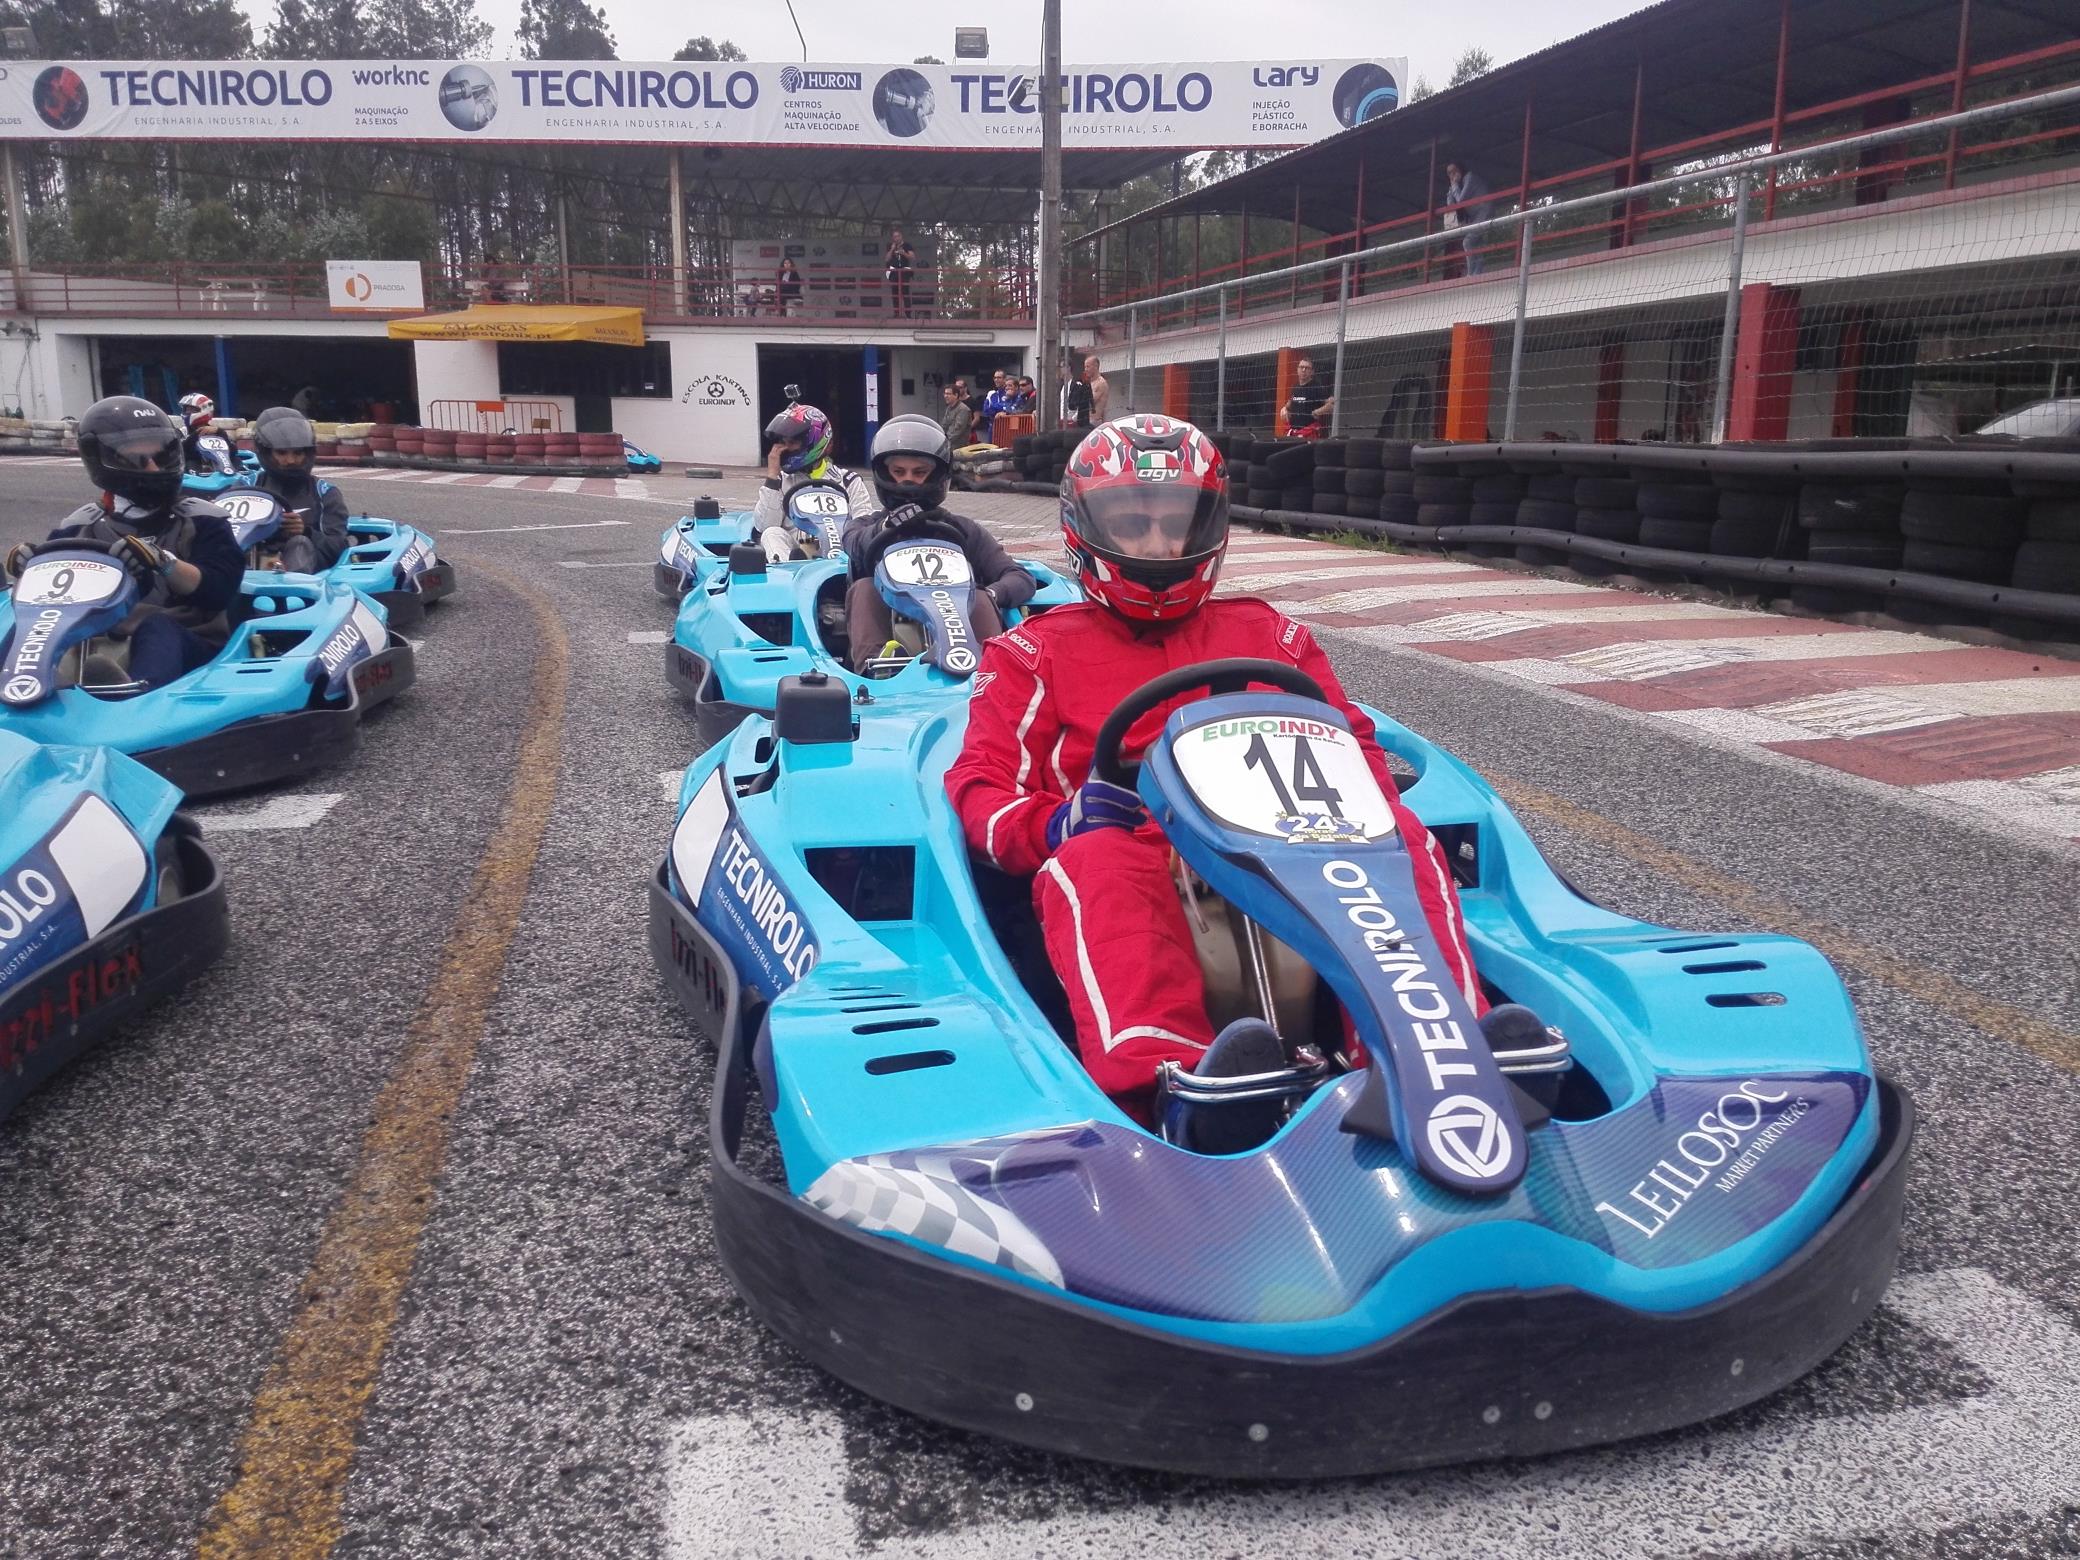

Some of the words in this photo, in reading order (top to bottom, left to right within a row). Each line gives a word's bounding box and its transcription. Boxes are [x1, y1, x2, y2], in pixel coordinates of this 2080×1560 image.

[352, 64, 430, 85] worknc
[808, 73, 857, 88] HURON
[100, 69, 333, 106] TECNIROLO
[511, 69, 759, 109] TECNIROLO
[354, 105, 409, 116] MAQUINAÇÃO
[784, 100, 822, 108] CENTROS
[1252, 99, 1290, 110] INJEÇÃO
[134, 116, 203, 126] ENGENHARIA
[355, 117, 361, 125] 2
[361, 117, 368, 125] A
[368, 117, 374, 125] 5
[374, 117, 398, 125] EIXOS
[784, 110, 841, 121] MAQUINAÇÃO
[1252, 110, 1295, 120] PLÁSTICO
[546, 118, 620, 128] ENGENHARIA
[625, 120, 699, 130] INDUSTRIAL,
[704, 120, 727, 129] S.A.
[784, 122, 806, 130] ALTA
[807, 122, 860, 131] VELOCIDADE
[1068, 124, 1147, 135] INDUSTRIAL,
[1152, 124, 1176, 134] S.A.
[1252, 123, 1258, 131] E
[1259, 122, 1308, 131] BORRACHA
[682, 375, 711, 404] ESCOLA
[715, 374, 752, 406] KARTING
[698, 398, 736, 406] EUROINDY
[208, 439, 224, 449] 22
[813, 495, 838, 512] 18
[896, 547, 956, 557] EUROINDY
[33, 561, 108, 572] EUROINDY
[911, 553, 949, 580] 12
[47, 568, 76, 599] 9
[1202, 720, 1339, 742] EUROINDY
[1243, 733, 1343, 818] 14
[1286, 815, 1340, 833] 24
[0, 869, 56, 947] OLO
[716, 886, 746, 932] ENGENHARIA
[720, 828, 814, 982] TECNIROLO
[0, 940, 43, 984] DUSTRIAL,
[1322, 860, 1478, 1091] TECNIROLO
[1715, 1148, 1758, 1193] MARKET
[1750, 1096, 1811, 1155] PARTNERS
[1595, 1081, 1788, 1239] LEILOSOC
